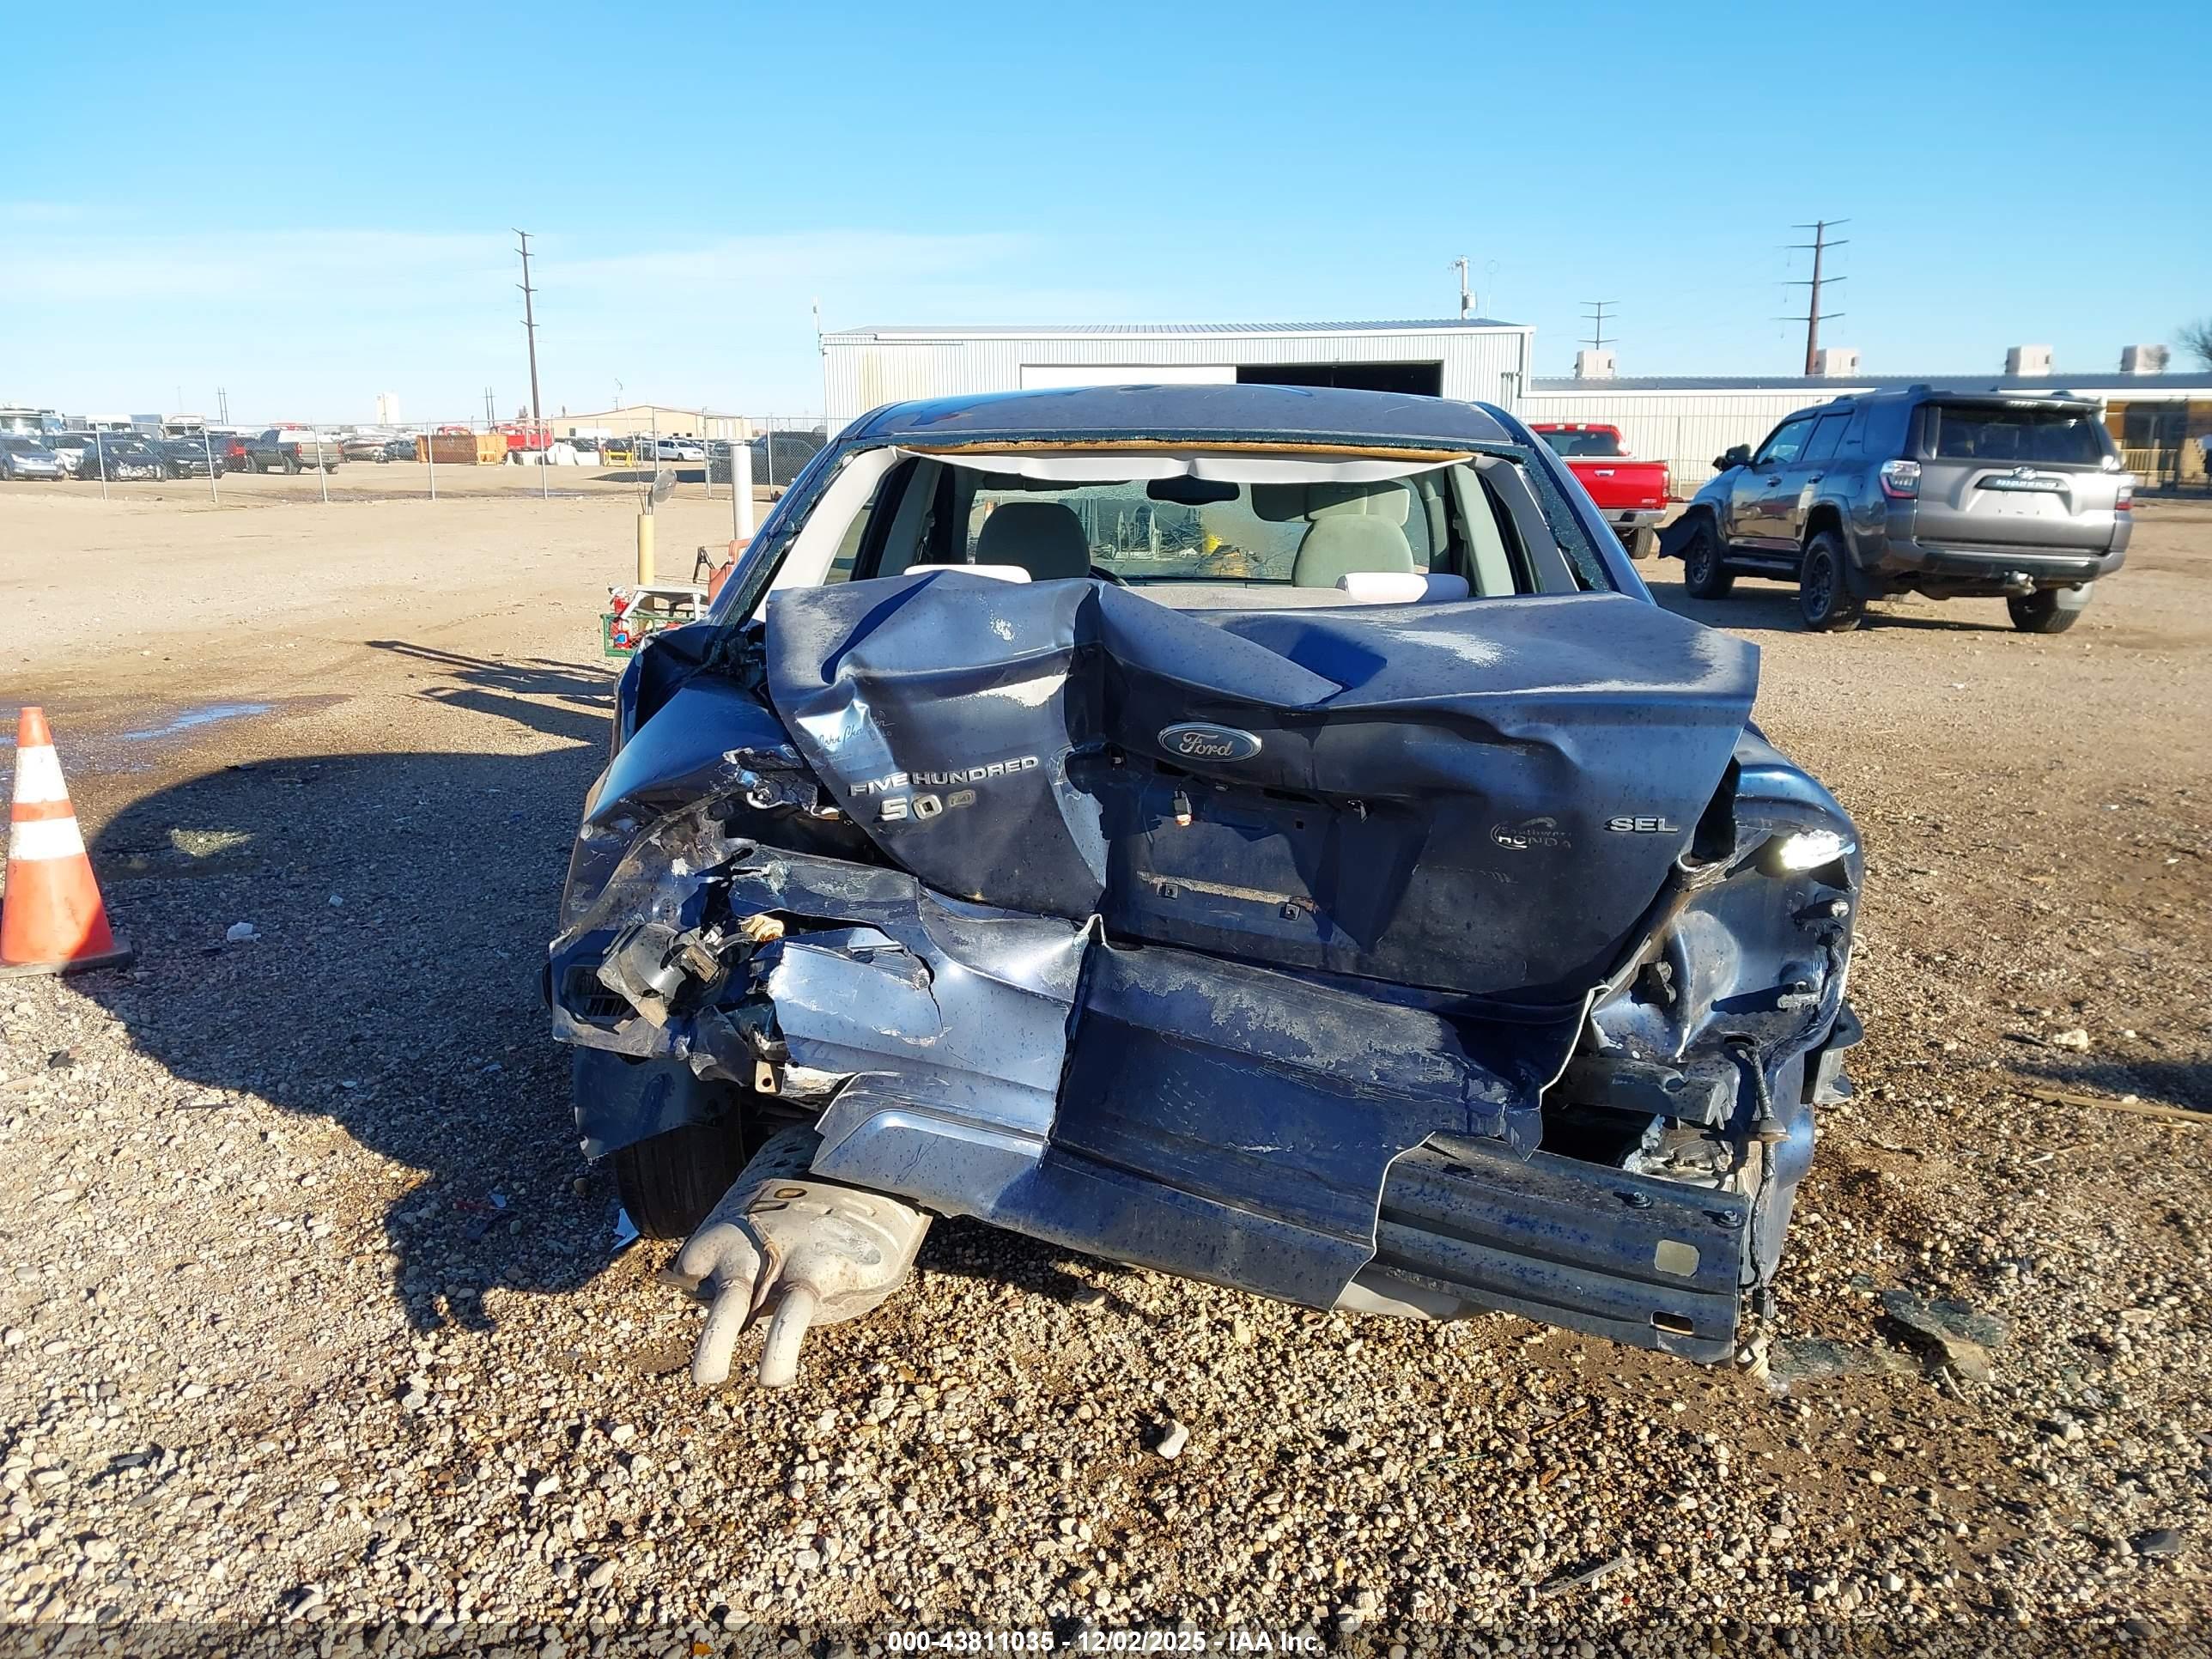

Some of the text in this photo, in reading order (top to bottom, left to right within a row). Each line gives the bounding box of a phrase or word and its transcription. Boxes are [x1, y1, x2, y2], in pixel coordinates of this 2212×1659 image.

[1179, 732, 1233, 757] Ford
[849, 755, 1039, 797] FIVE HUNDRED
[1609, 816, 1679, 833] SEL
